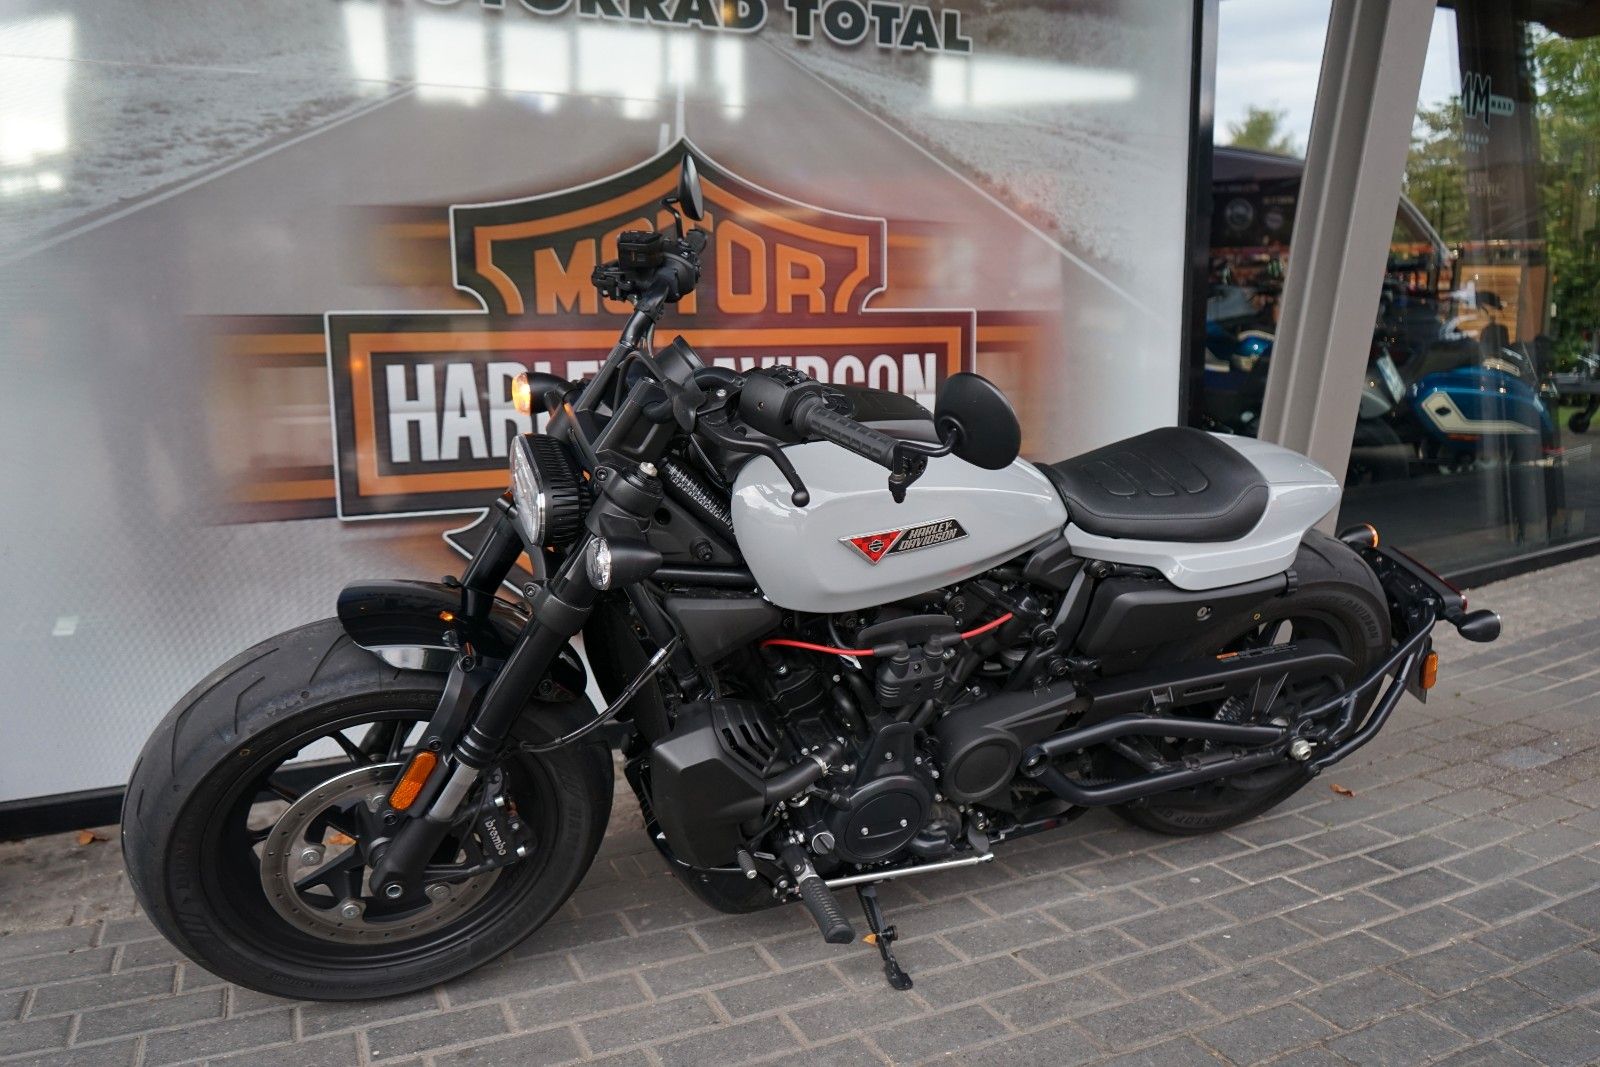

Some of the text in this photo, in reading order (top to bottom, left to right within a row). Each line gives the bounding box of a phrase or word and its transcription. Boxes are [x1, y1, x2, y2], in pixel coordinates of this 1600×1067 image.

[784, 0, 973, 54] TOTAL
[386, 360, 607, 463] HAR
[899, 528, 958, 551] DAVIDSON
[908, 521, 953, 540] HARLEY
[483, 818, 507, 856] brembo
